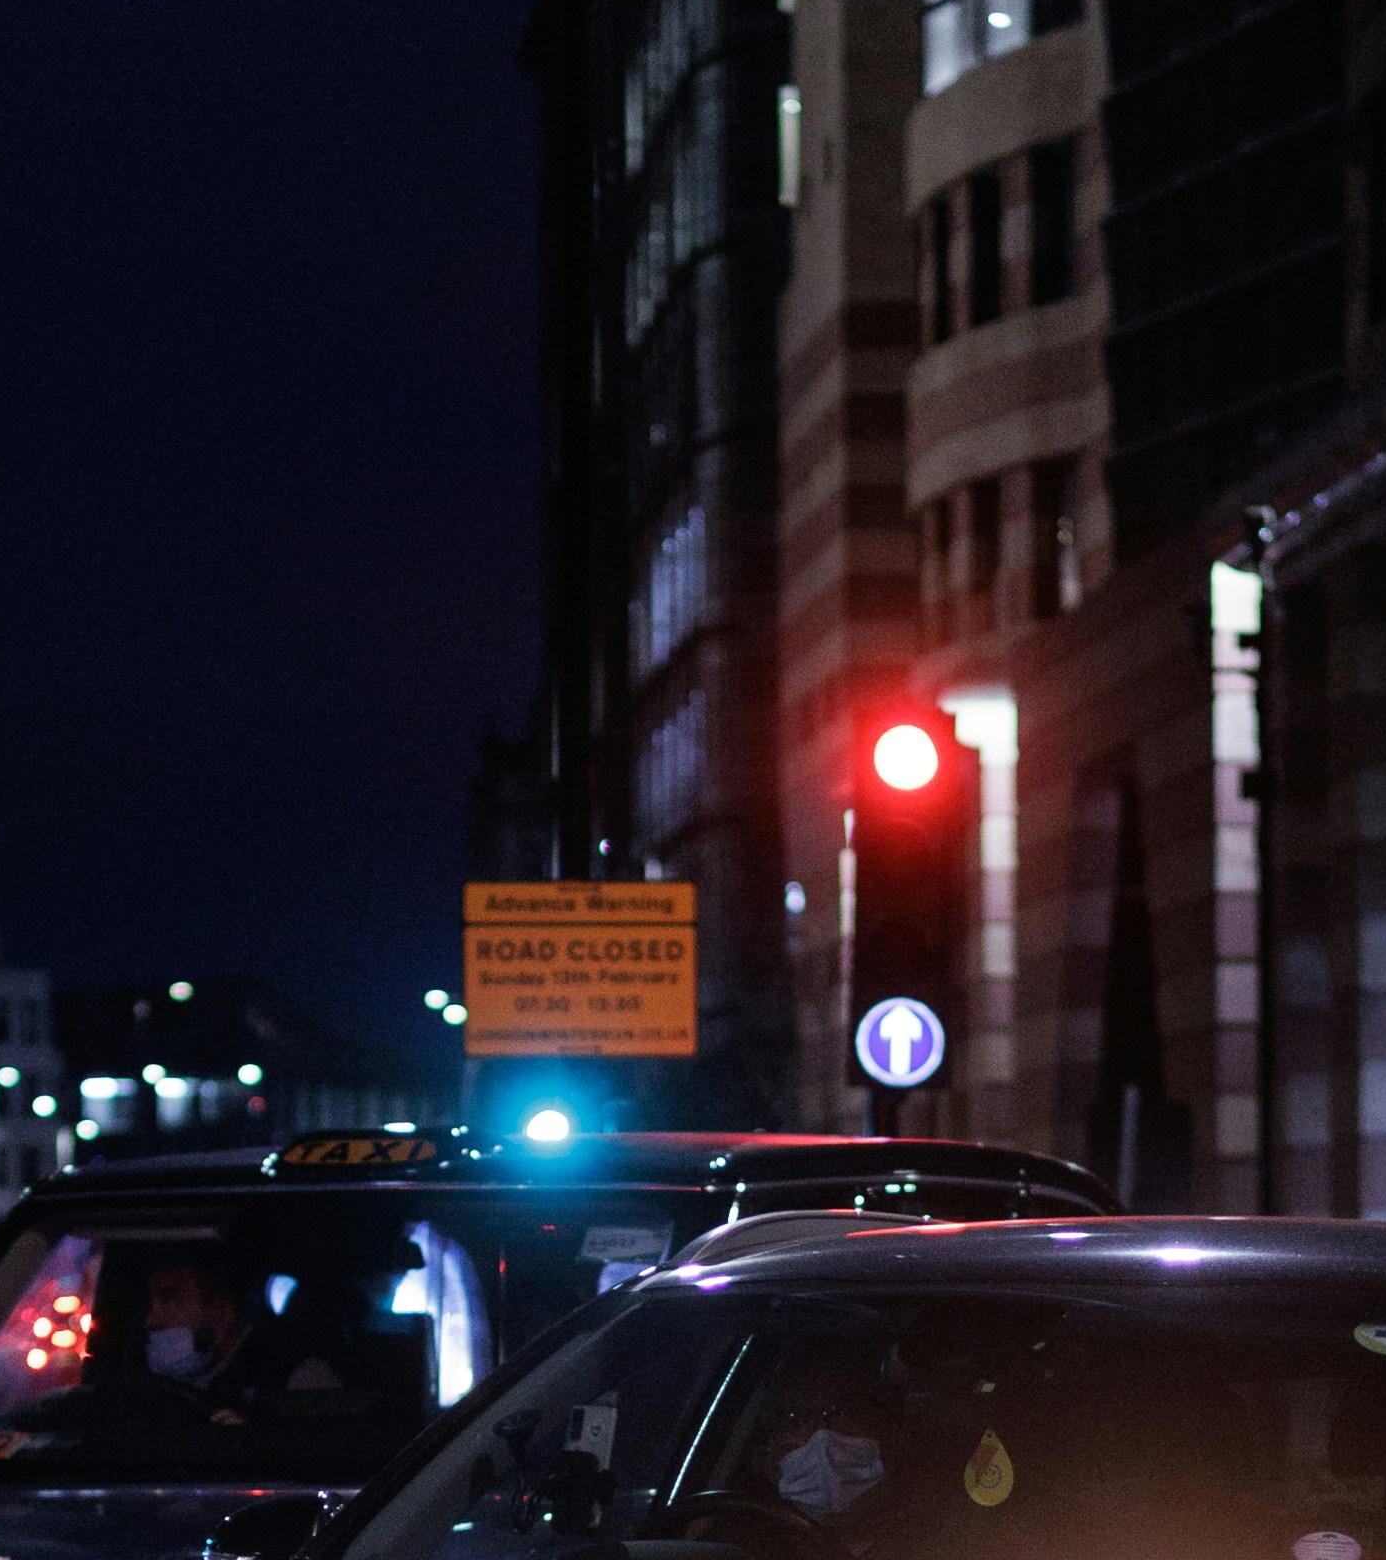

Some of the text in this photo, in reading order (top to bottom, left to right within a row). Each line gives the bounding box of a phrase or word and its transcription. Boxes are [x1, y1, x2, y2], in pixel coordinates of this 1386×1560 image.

[476, 939, 685, 962] ROAD CLOSED
[300, 1141, 424, 1162] TAXI
